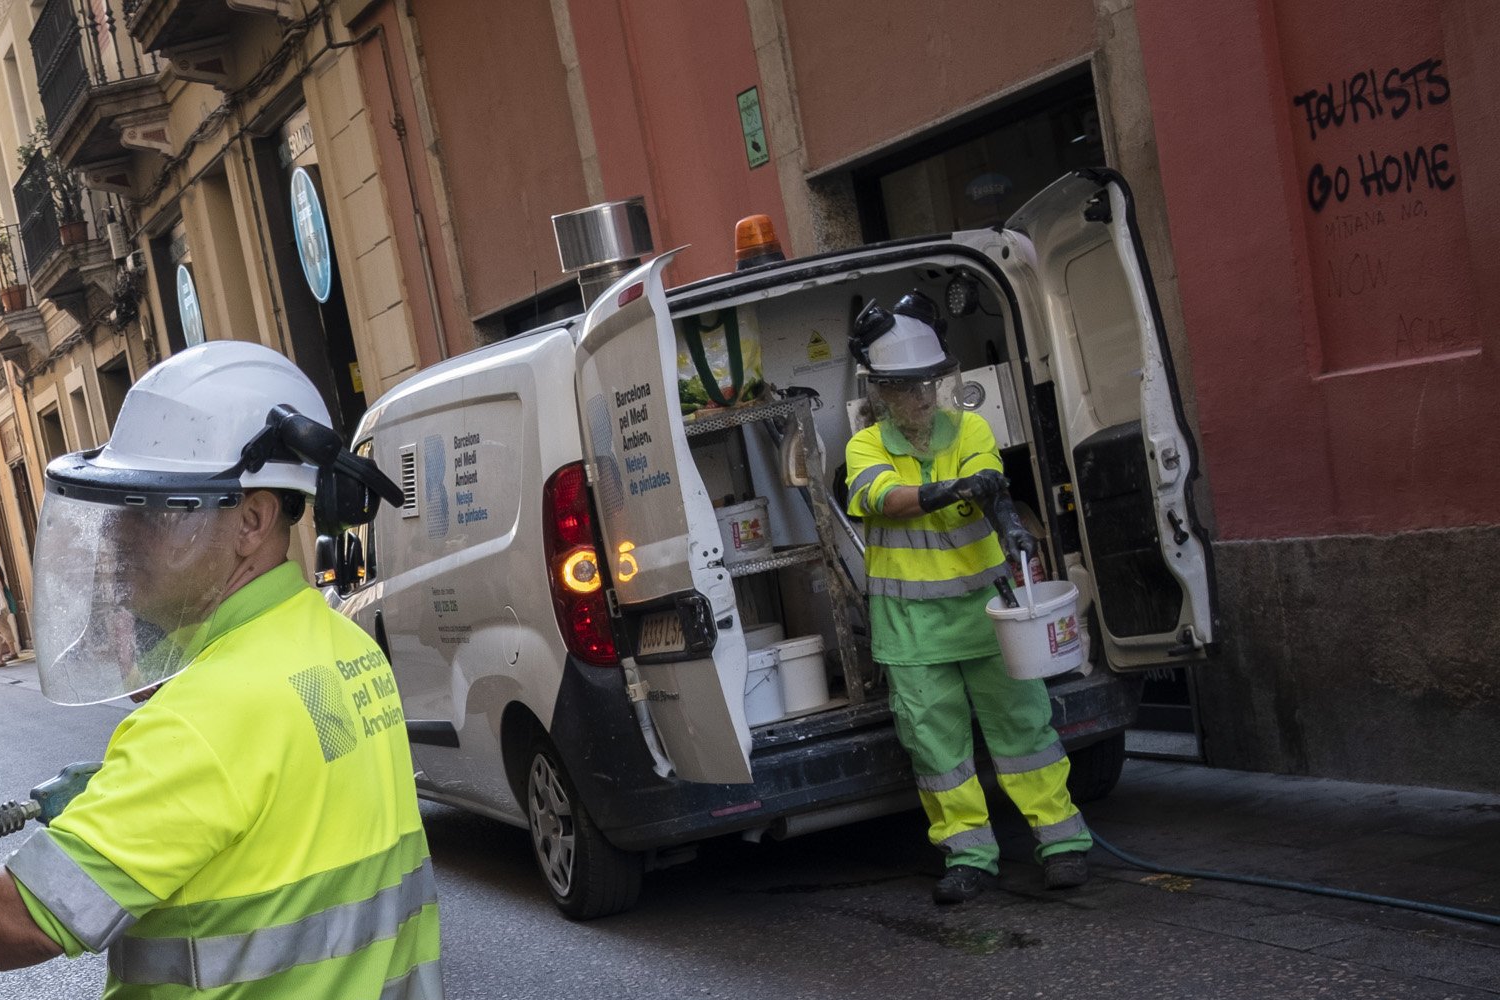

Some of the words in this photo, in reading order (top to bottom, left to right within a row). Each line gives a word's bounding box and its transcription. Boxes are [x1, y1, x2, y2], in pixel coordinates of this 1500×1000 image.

[1293, 58, 1451, 140] TOURISTS
[1307, 163, 1350, 213] GO
[1357, 143, 1455, 197] HOME
[615, 381, 651, 408] Barcelona
[619, 413, 630, 434] pel
[630, 405, 649, 426] Medi
[454, 431, 481, 450] Barcelona
[454, 454, 463, 472] pel
[464, 450, 477, 466] Medi
[624, 452, 648, 475] Neteja
[455, 469, 478, 488] Ambient
[629, 480, 640, 496] de
[639, 470, 671, 496] pintades
[456, 491, 474, 507] Neteja
[457, 510, 465, 524] de
[465, 507, 488, 526] pintades
[336, 648, 387, 681] Barcelon
[352, 682, 372, 715] pel
[361, 704, 404, 739] Ambien
